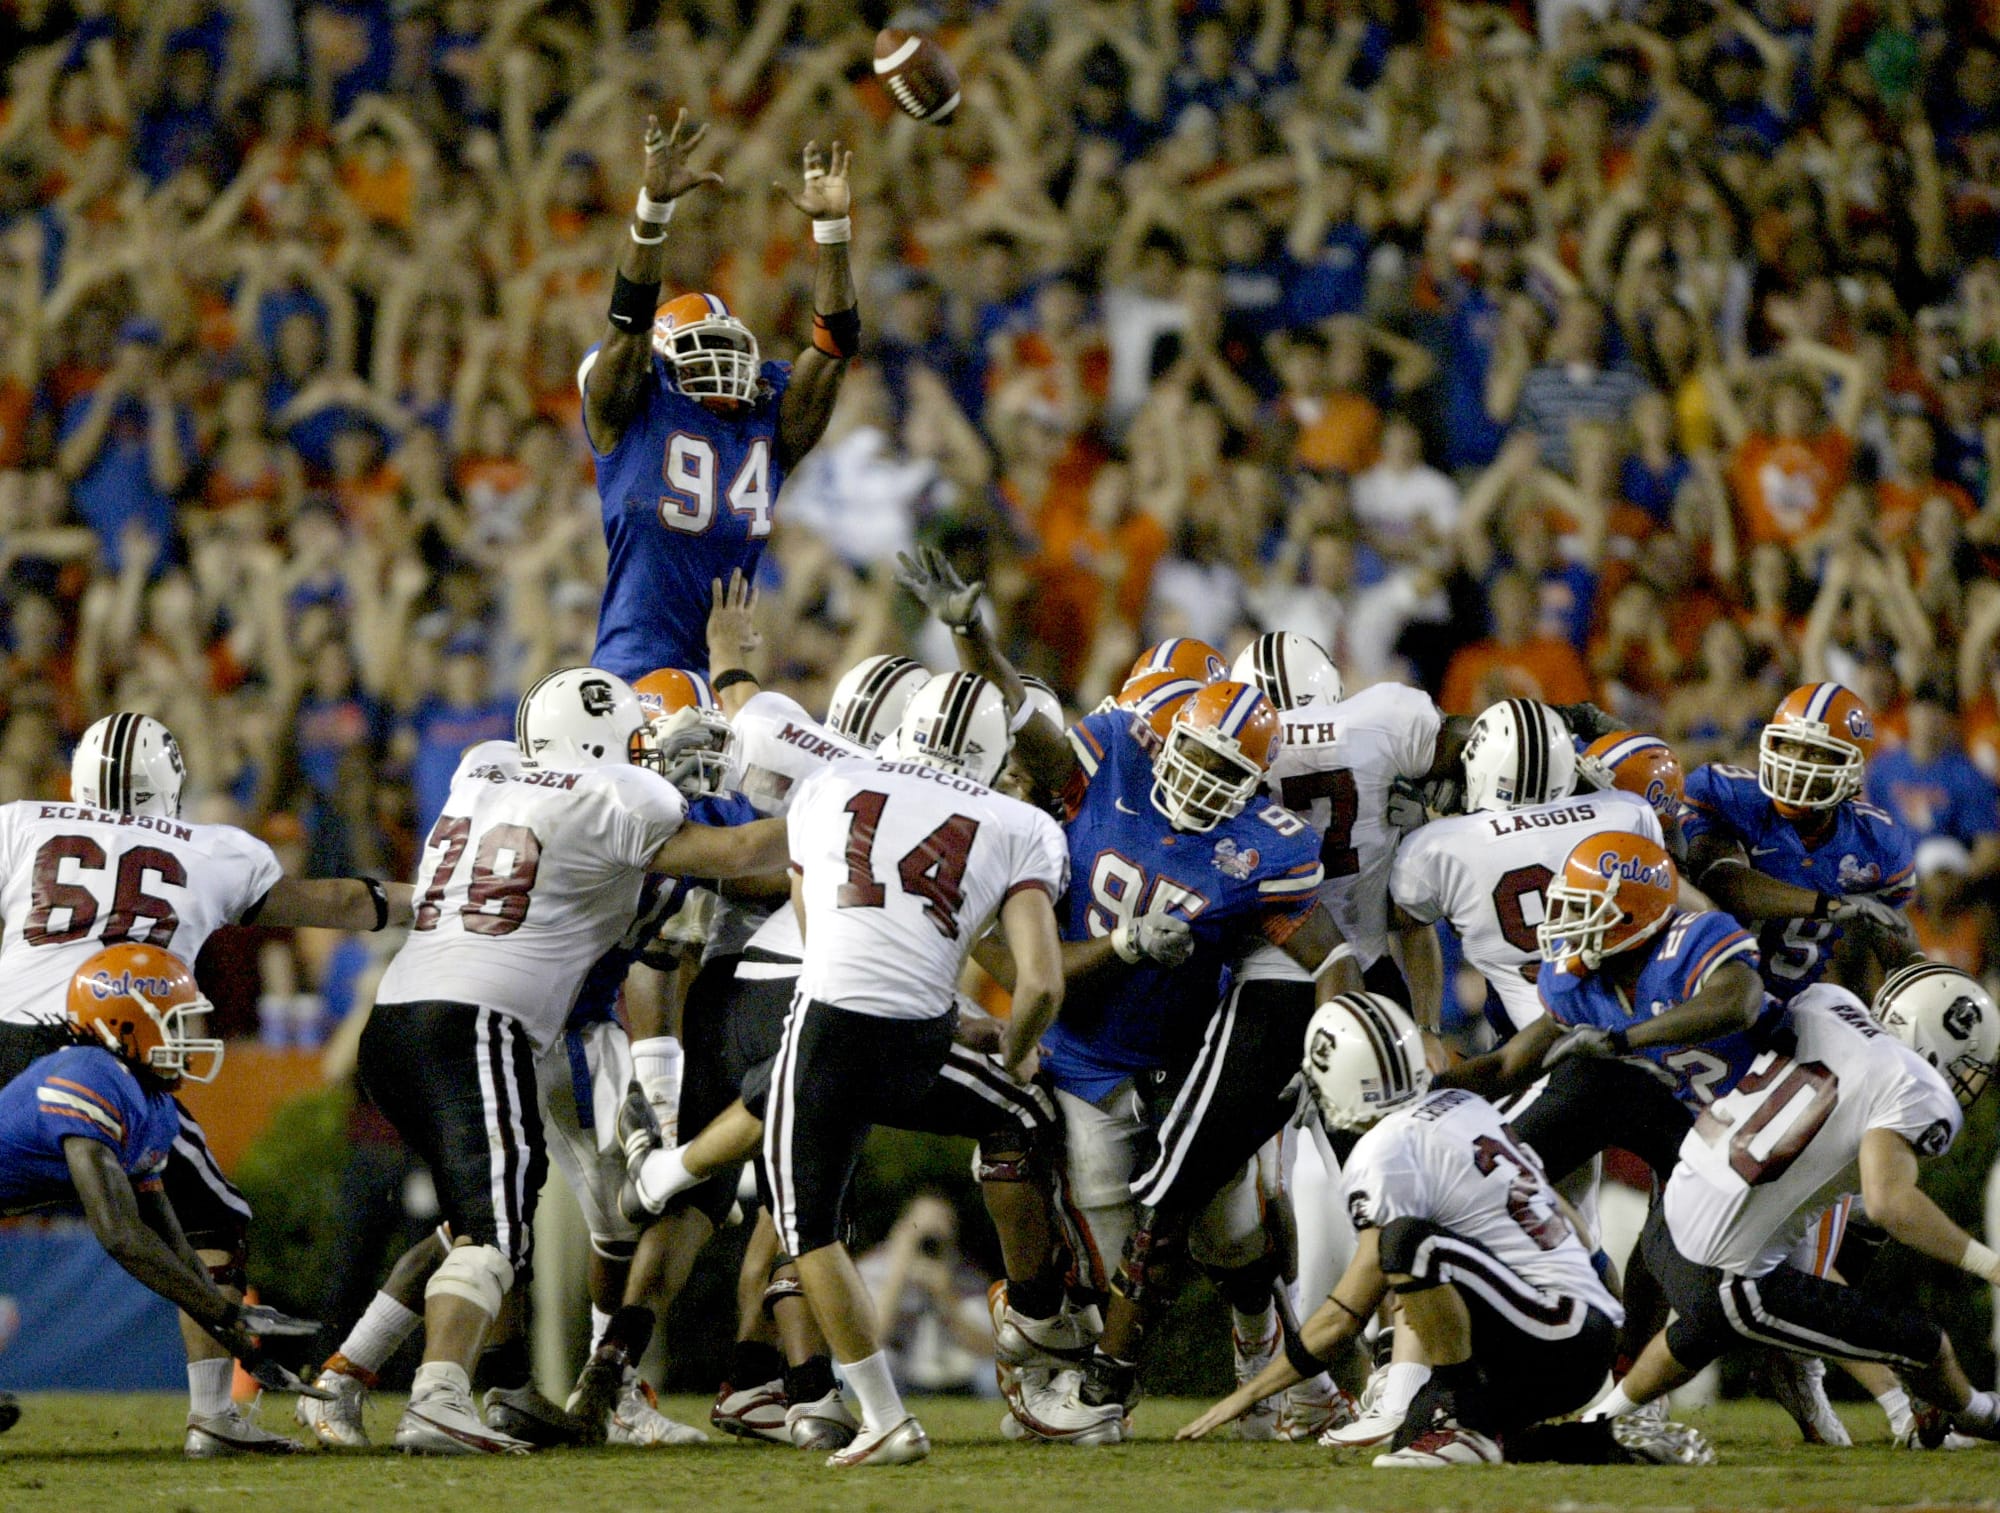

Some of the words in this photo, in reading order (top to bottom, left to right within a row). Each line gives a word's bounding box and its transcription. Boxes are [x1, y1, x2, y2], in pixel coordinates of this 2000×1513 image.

[657, 429, 774, 540] 94
[776, 721, 864, 762] MORG
[1281, 721, 1338, 746] ITH
[877, 761, 990, 798] SUCCOP
[39, 806, 193, 842] ECKERSON
[1489, 804, 1597, 837] LAGGIS
[413, 815, 544, 937] 78
[837, 789, 981, 941] 14
[1598, 851, 1672, 890] Gators
[22, 834, 189, 949] 66
[91, 969, 172, 1000] Gators
